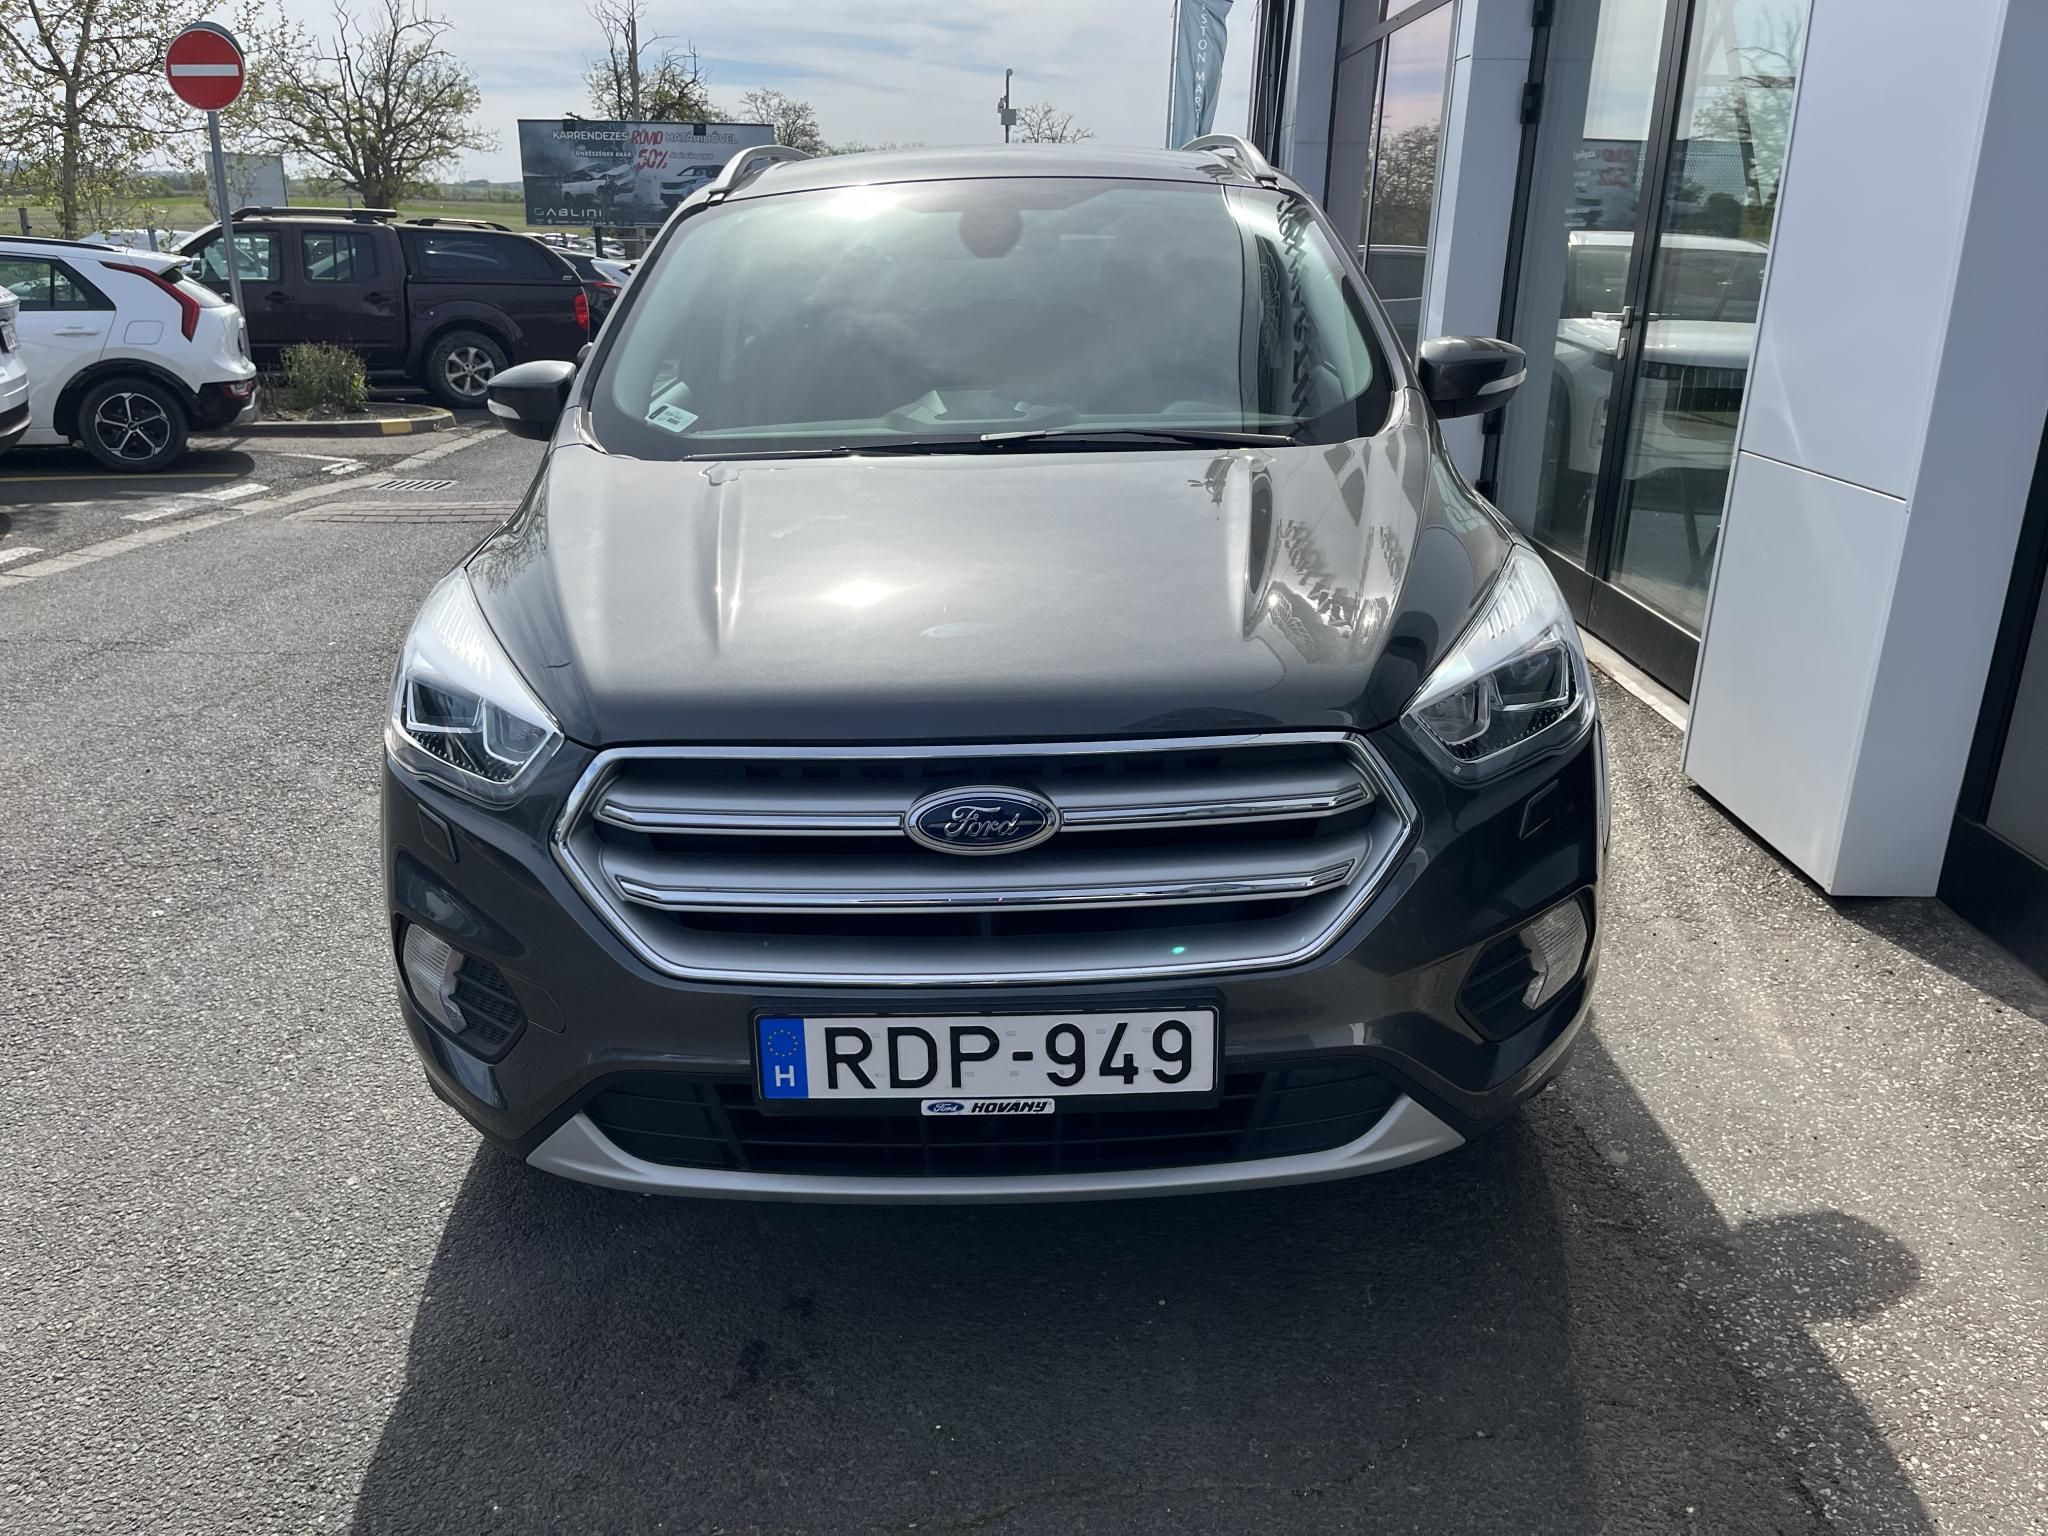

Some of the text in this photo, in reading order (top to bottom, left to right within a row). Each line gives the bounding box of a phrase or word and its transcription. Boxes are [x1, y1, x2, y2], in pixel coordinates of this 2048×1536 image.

[1197, 3, 1208, 63] STON
[634, 149, 669, 169] 50%
[534, 208, 603, 218] GABLINI
[944, 805, 1020, 838] Ford
[775, 1019, 1193, 1089] H RDP-949
[933, 1103, 958, 1112] Ford
